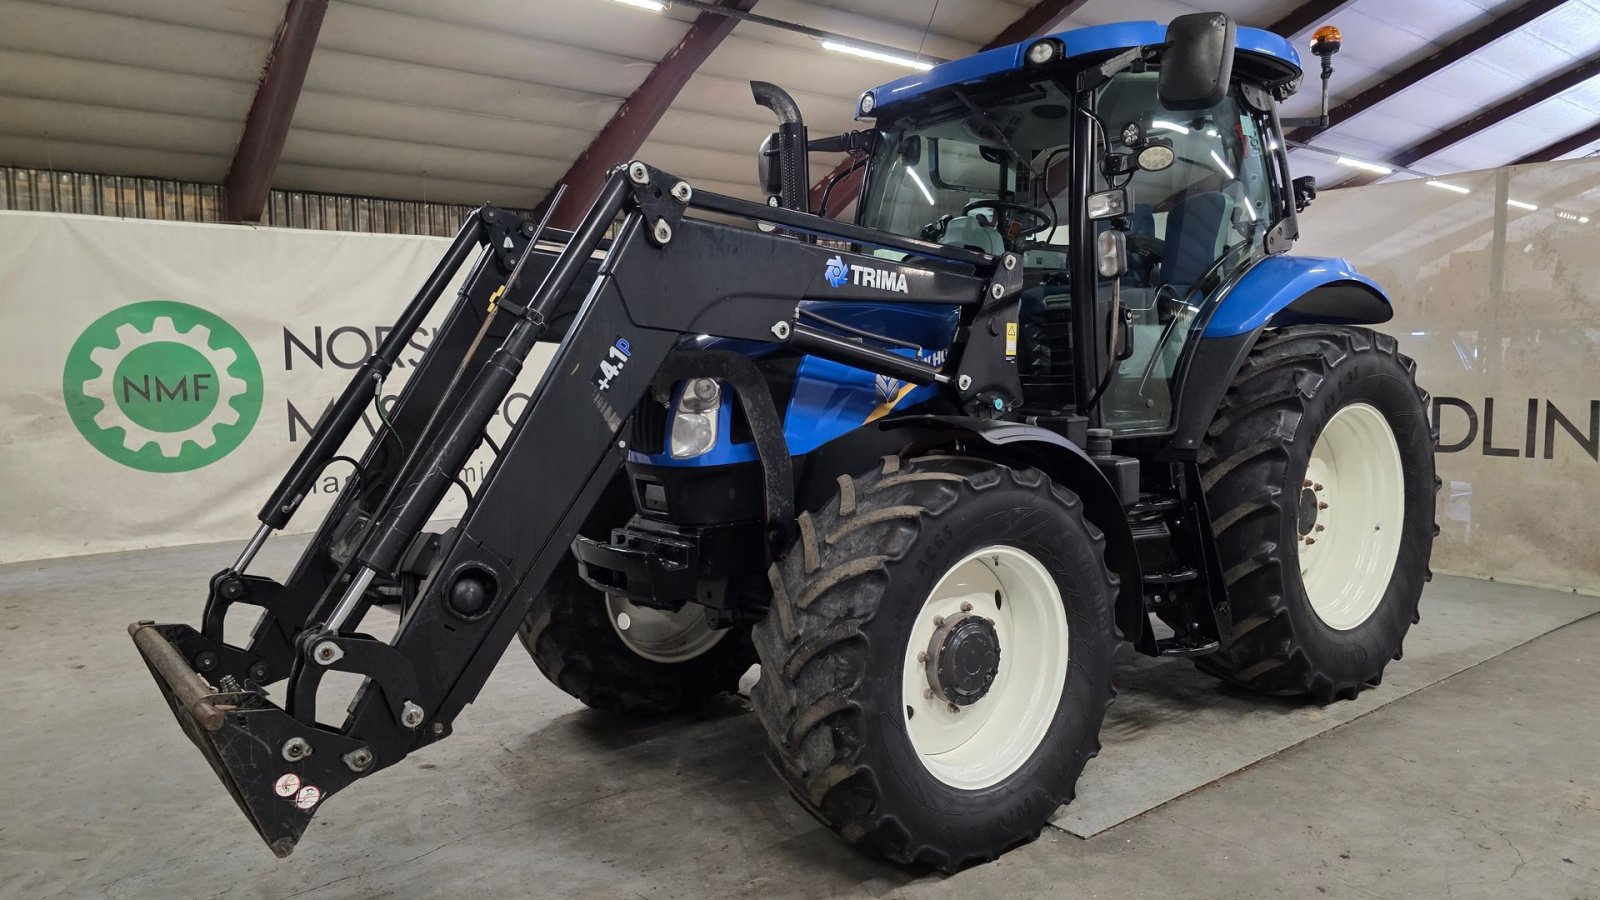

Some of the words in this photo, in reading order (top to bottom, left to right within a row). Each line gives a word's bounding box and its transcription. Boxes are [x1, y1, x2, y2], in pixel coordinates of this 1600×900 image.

[851, 264, 909, 294] TRIMA
[123, 374, 211, 403] NMF
[1432, 396, 1600, 462] DLIN
